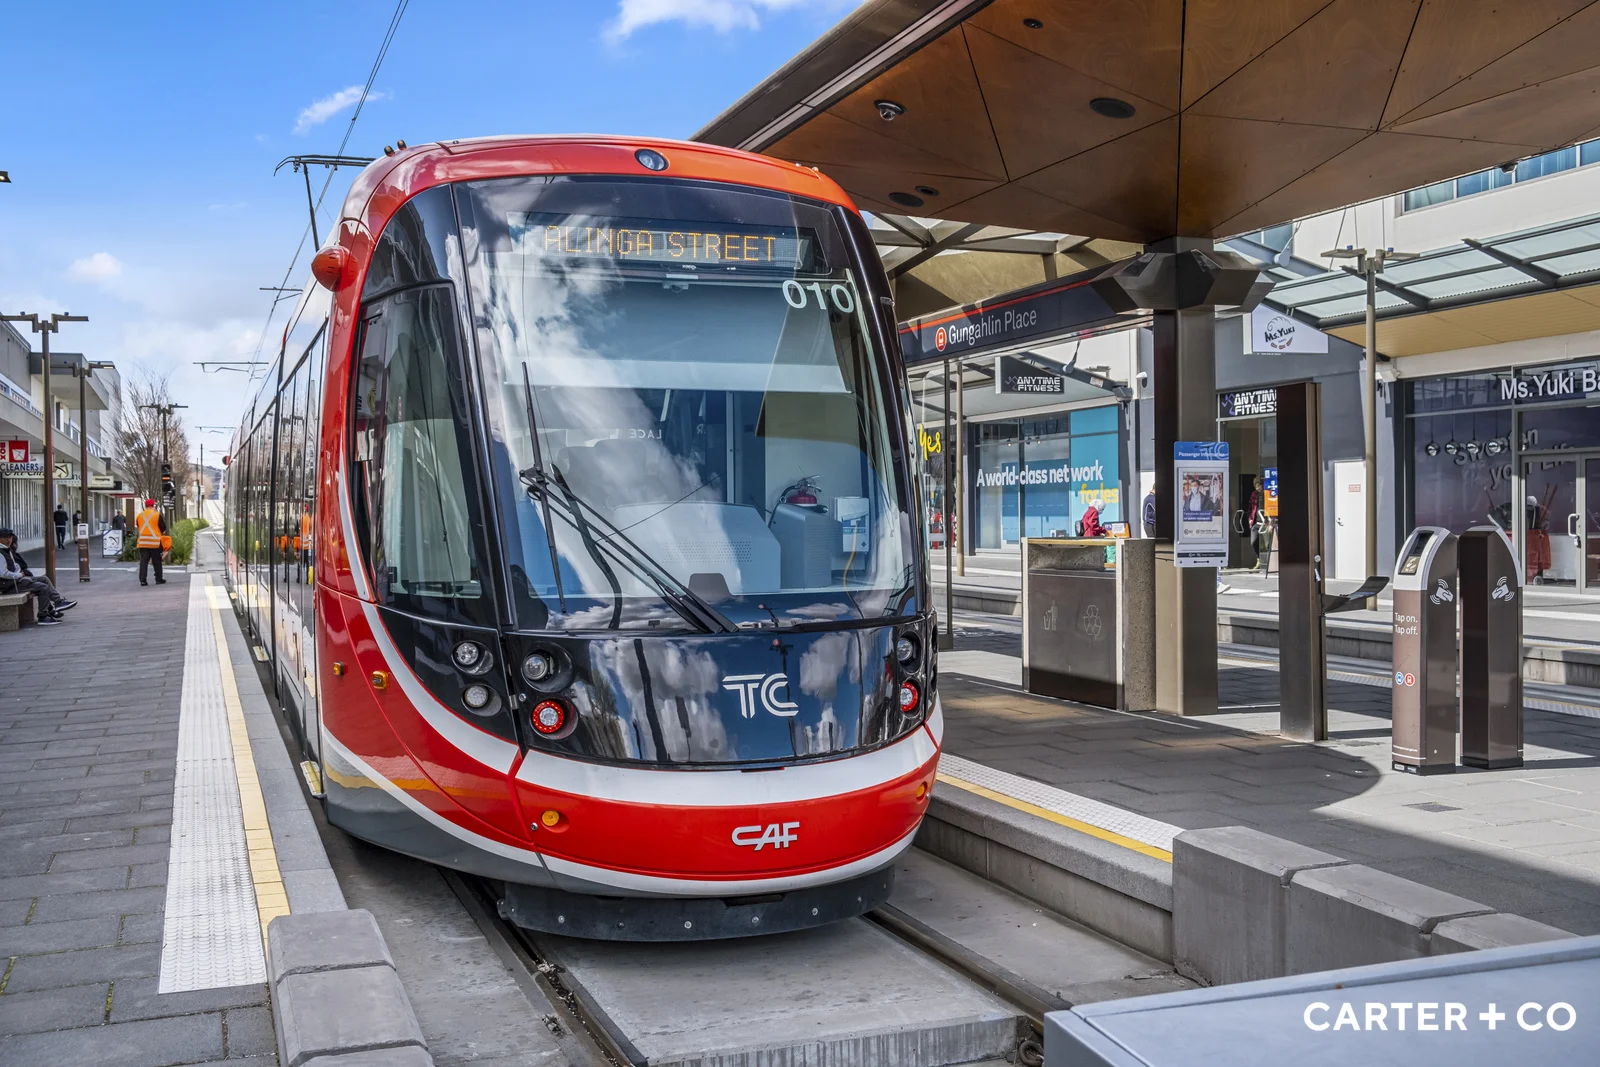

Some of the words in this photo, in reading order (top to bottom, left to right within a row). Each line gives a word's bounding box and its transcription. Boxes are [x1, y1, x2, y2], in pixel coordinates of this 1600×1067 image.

[545, 225, 652, 256] ALINGA
[668, 231, 776, 262] STREET
[782, 279, 855, 314] 010
[948, 315, 1002, 346] Gungahlin
[1004, 309, 1037, 332] Place
[1016, 376, 1061, 385] ANYTIME
[1017, 384, 1061, 392] FITNESS
[1233, 388, 1277, 406] ANYTIM
[1234, 401, 1277, 416] FITNES
[0, 463, 39, 471] CLEANERS
[976, 468, 987, 487] A
[986, 464, 1048, 487] world-class
[1080, 483, 1099, 505] for
[1394, 612, 1405, 623] Tap
[1394, 624, 1405, 635] Tap
[1405, 626, 1418, 635] off.
[722, 673, 799, 719] TC
[731, 821, 800, 851] CAF
